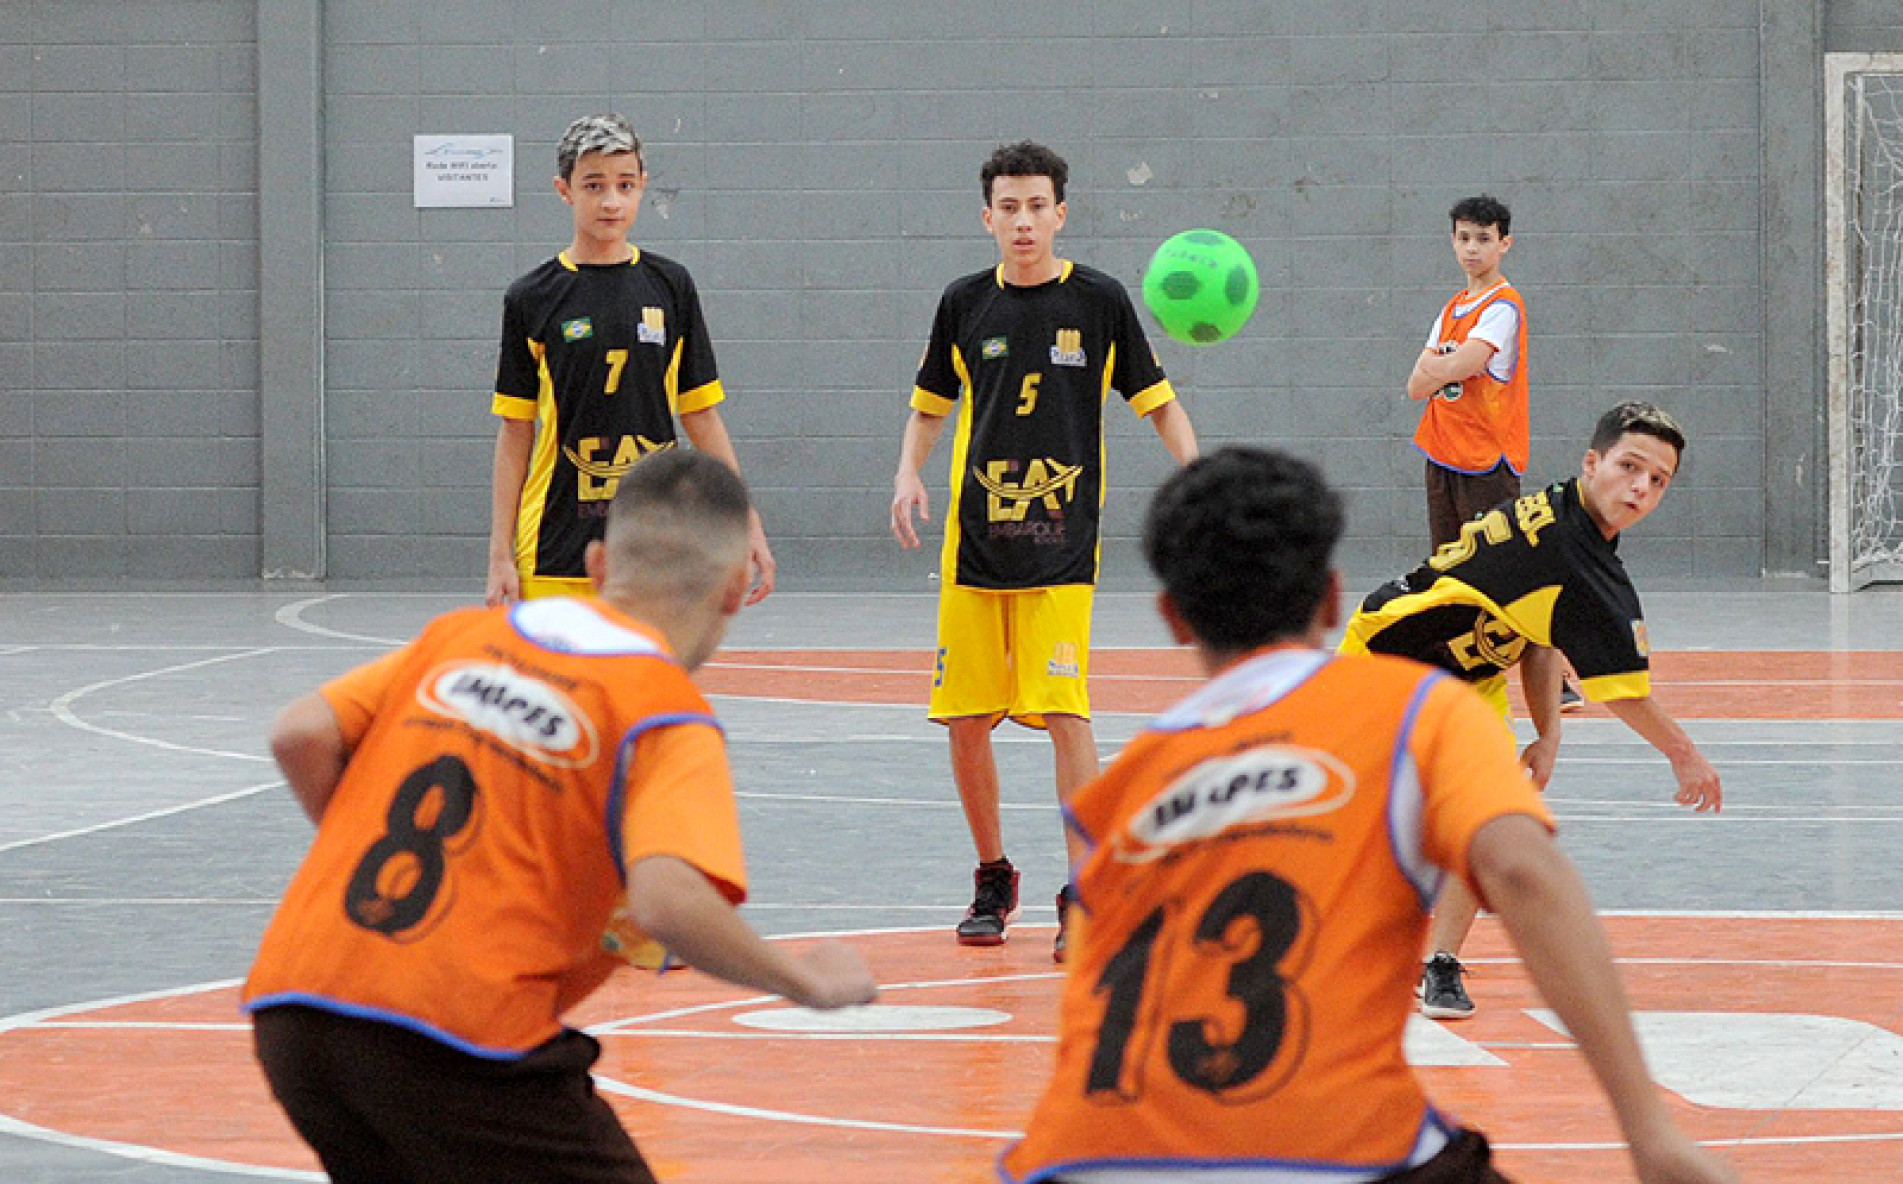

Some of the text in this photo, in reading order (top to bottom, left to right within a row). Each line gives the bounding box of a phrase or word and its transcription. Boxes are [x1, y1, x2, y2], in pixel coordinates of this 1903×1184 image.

[604, 349, 629, 395] 7
[1015, 372, 1043, 416] 5
[344, 753, 481, 937] 8
[1084, 869, 1303, 1097] 13
